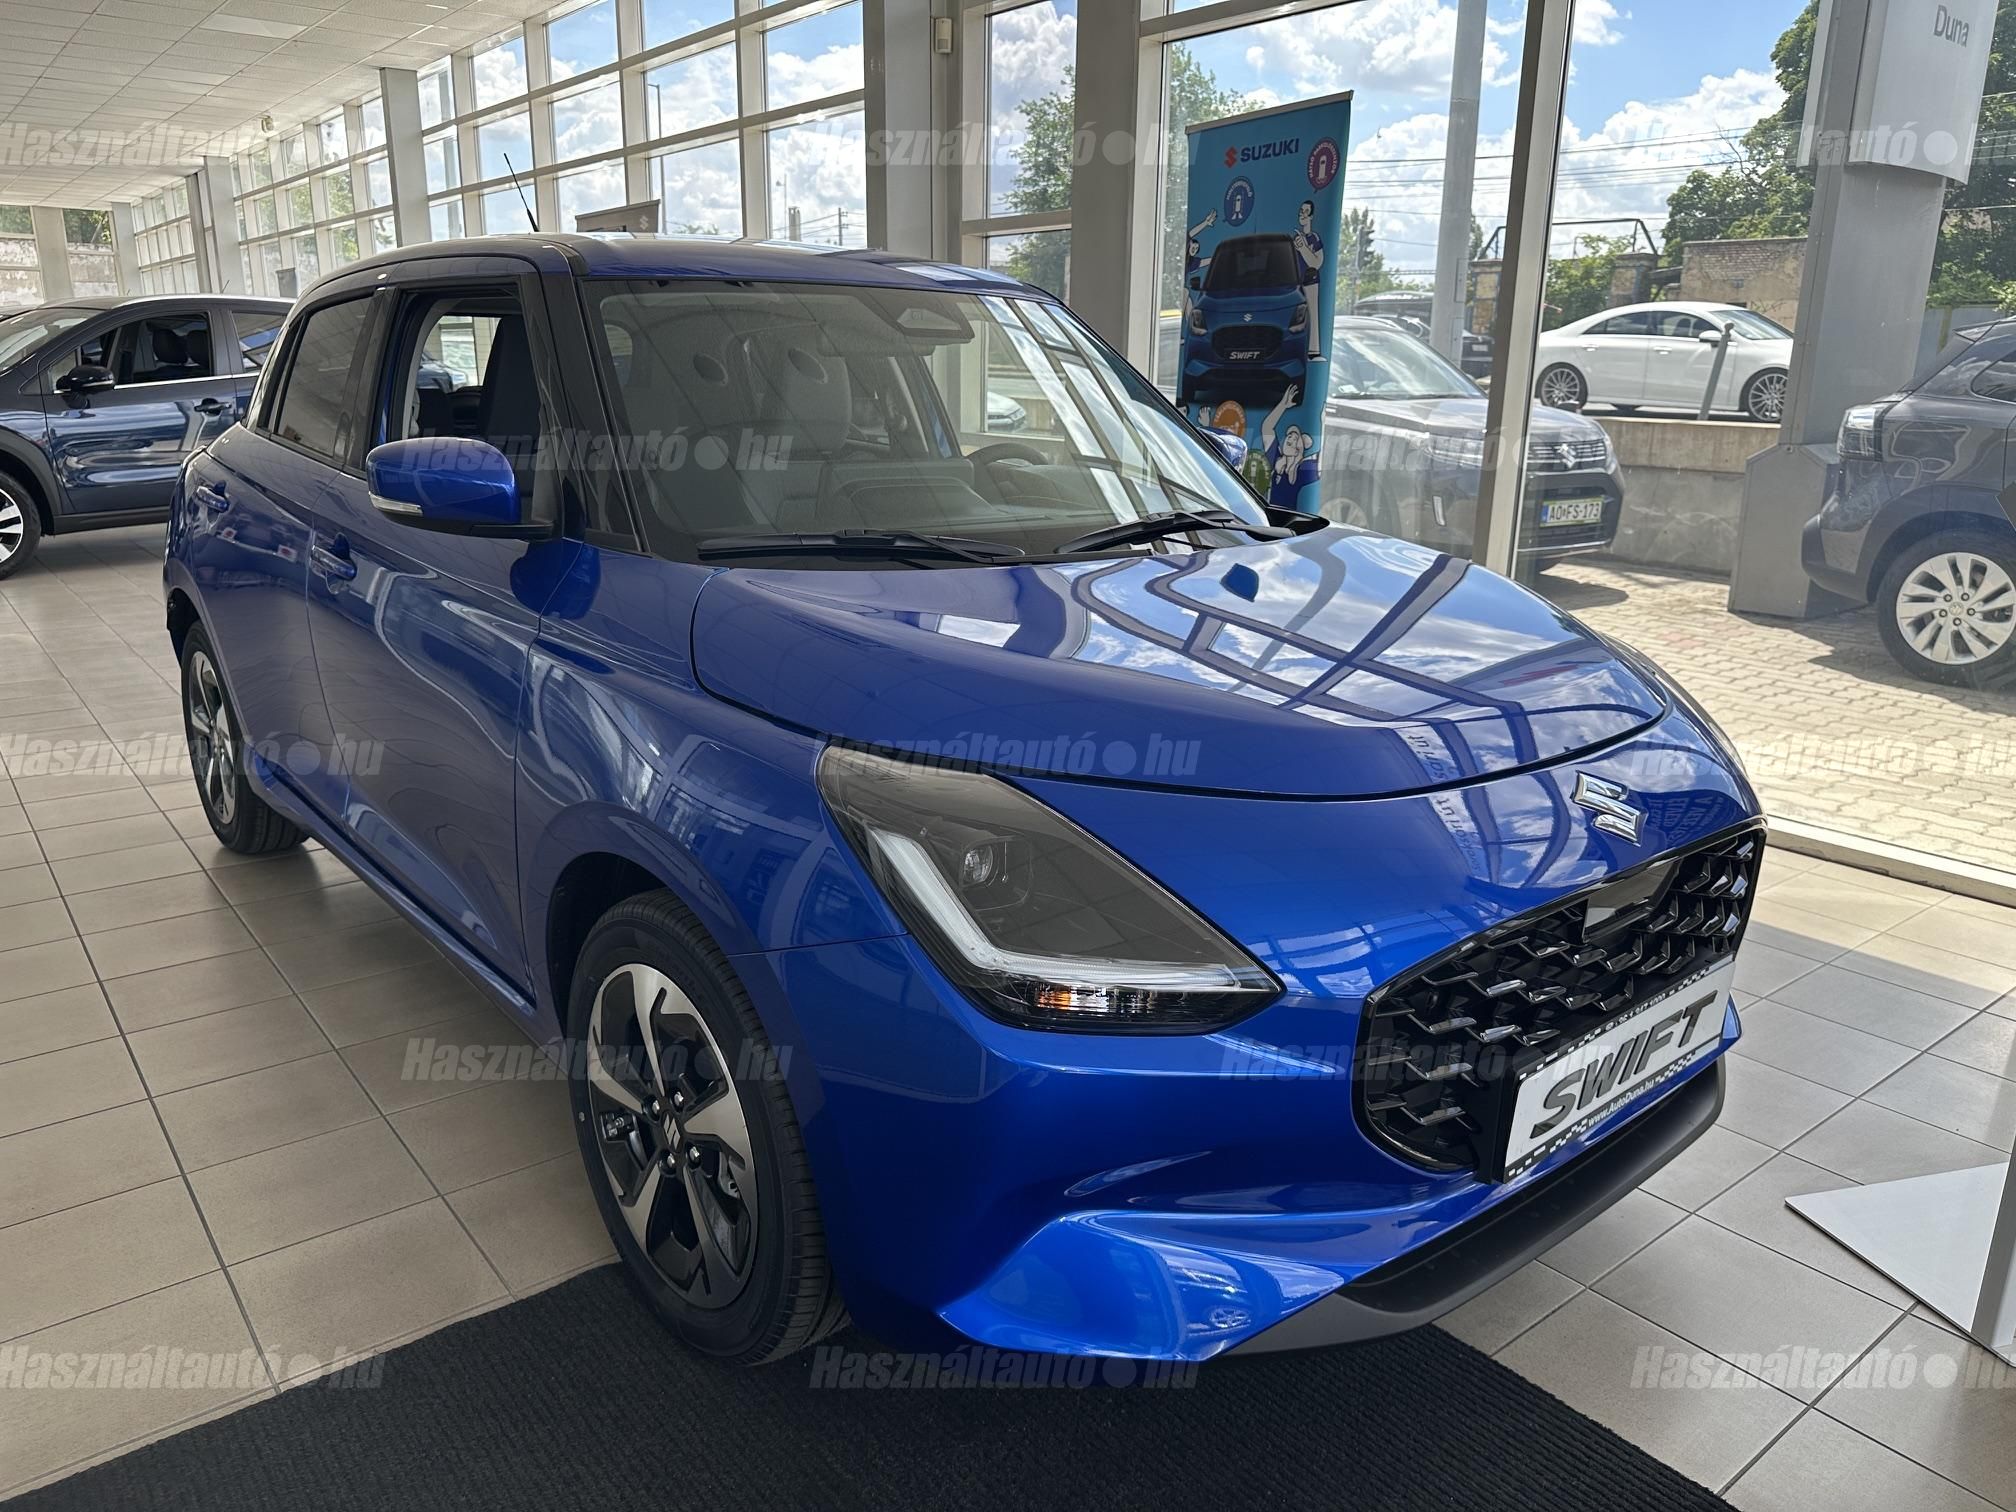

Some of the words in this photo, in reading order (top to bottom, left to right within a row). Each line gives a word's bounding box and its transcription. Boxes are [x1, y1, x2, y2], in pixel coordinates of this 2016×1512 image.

[1933, 4, 1969, 48] Duna
[1240, 138, 1299, 162] SUZUKI
[1229, 351, 1260, 360] SWIFT
[1529, 990, 1718, 1139] SWIFT
